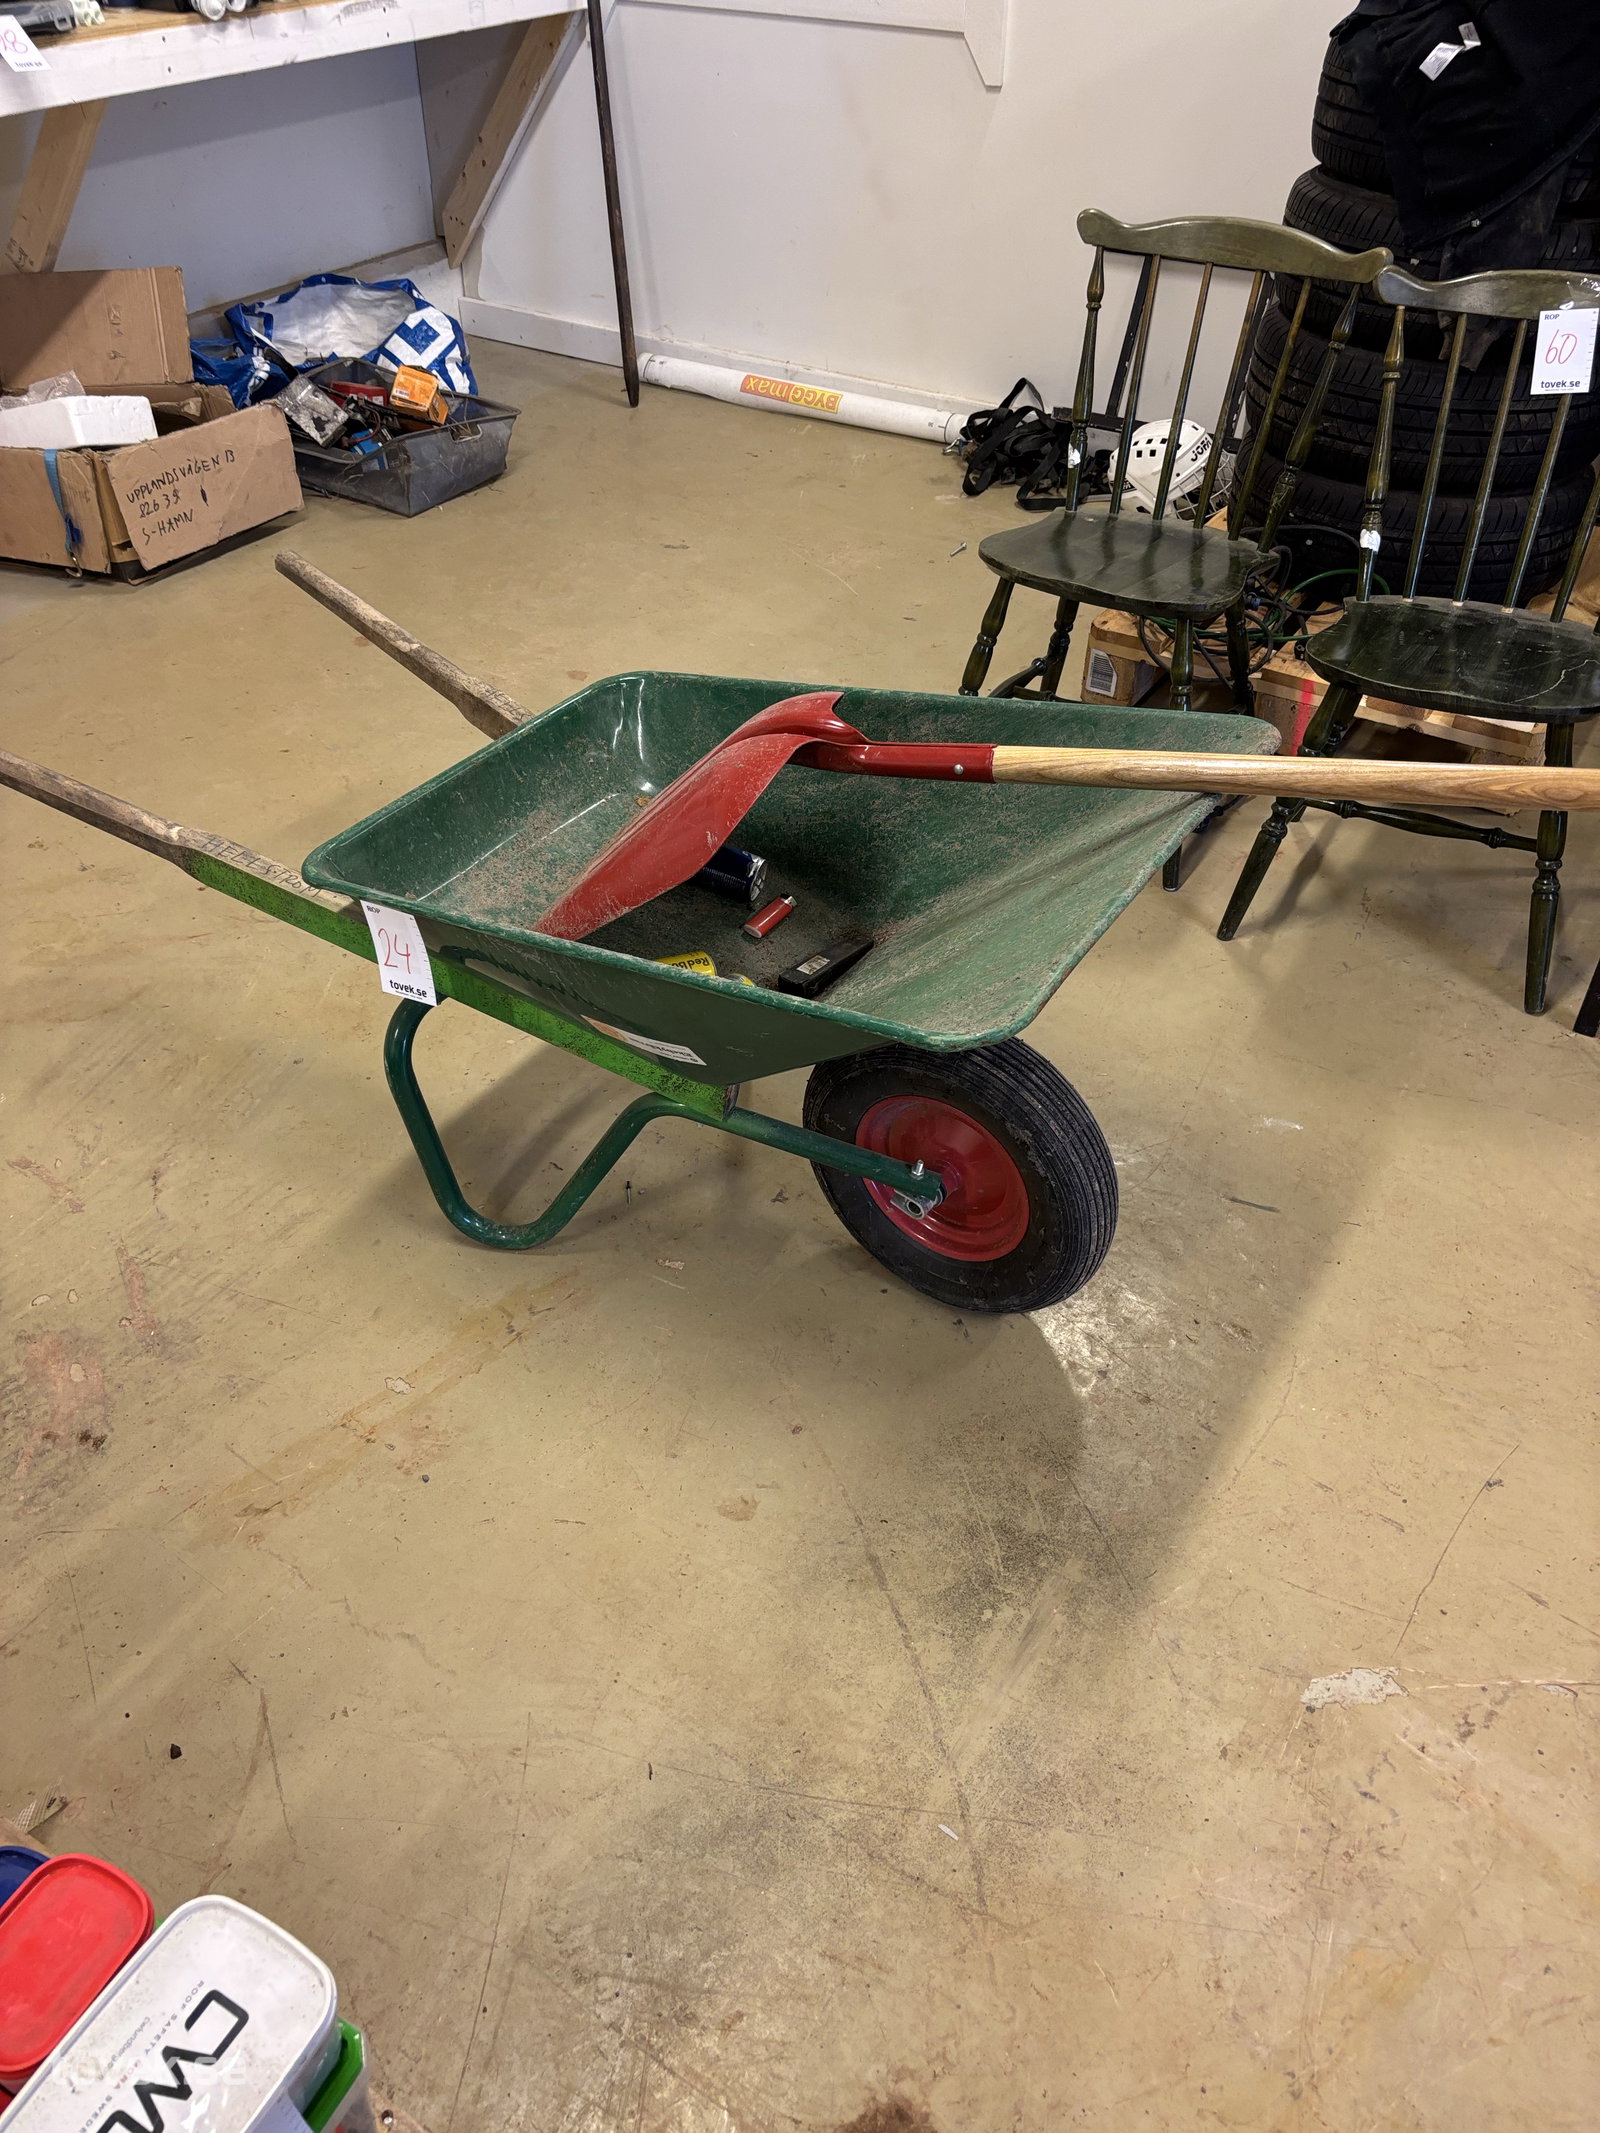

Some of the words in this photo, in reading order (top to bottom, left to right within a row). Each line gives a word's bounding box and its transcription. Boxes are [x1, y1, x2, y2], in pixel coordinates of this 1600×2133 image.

[1545, 329, 1577, 364] 60
[1540, 380, 1581, 389] tovek.se
[378, 927, 411, 974] 24
[389, 980, 428, 998] tovek.se
[181, 1980, 205, 2010] ROOF
[144, 2013, 178, 2056] SAFETY
